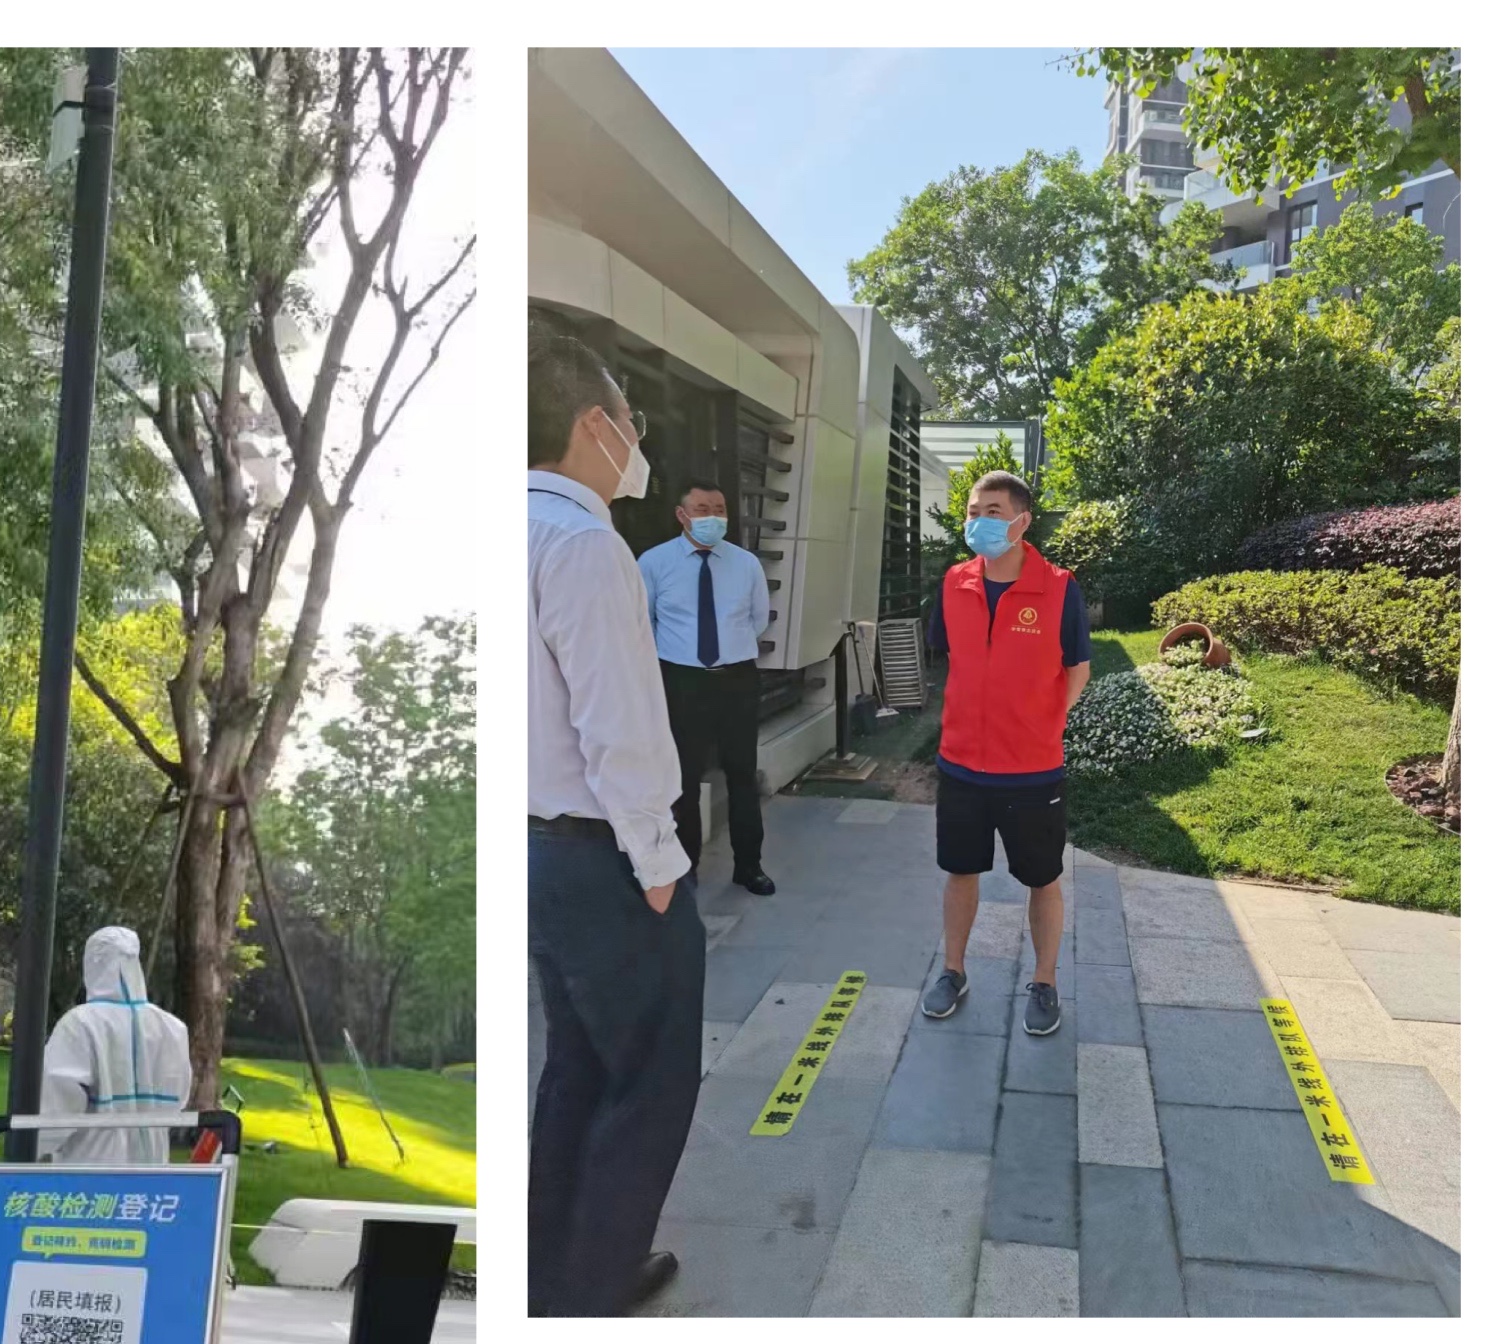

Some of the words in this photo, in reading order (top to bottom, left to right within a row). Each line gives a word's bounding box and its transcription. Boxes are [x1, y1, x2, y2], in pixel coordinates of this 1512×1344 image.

[763, 975, 867, 1125] 请在一米线外排队等候
[1266, 1004, 1360, 1169] 请在一米线外排队等候
[4, 1191, 179, 1222] 核酸检测登记
